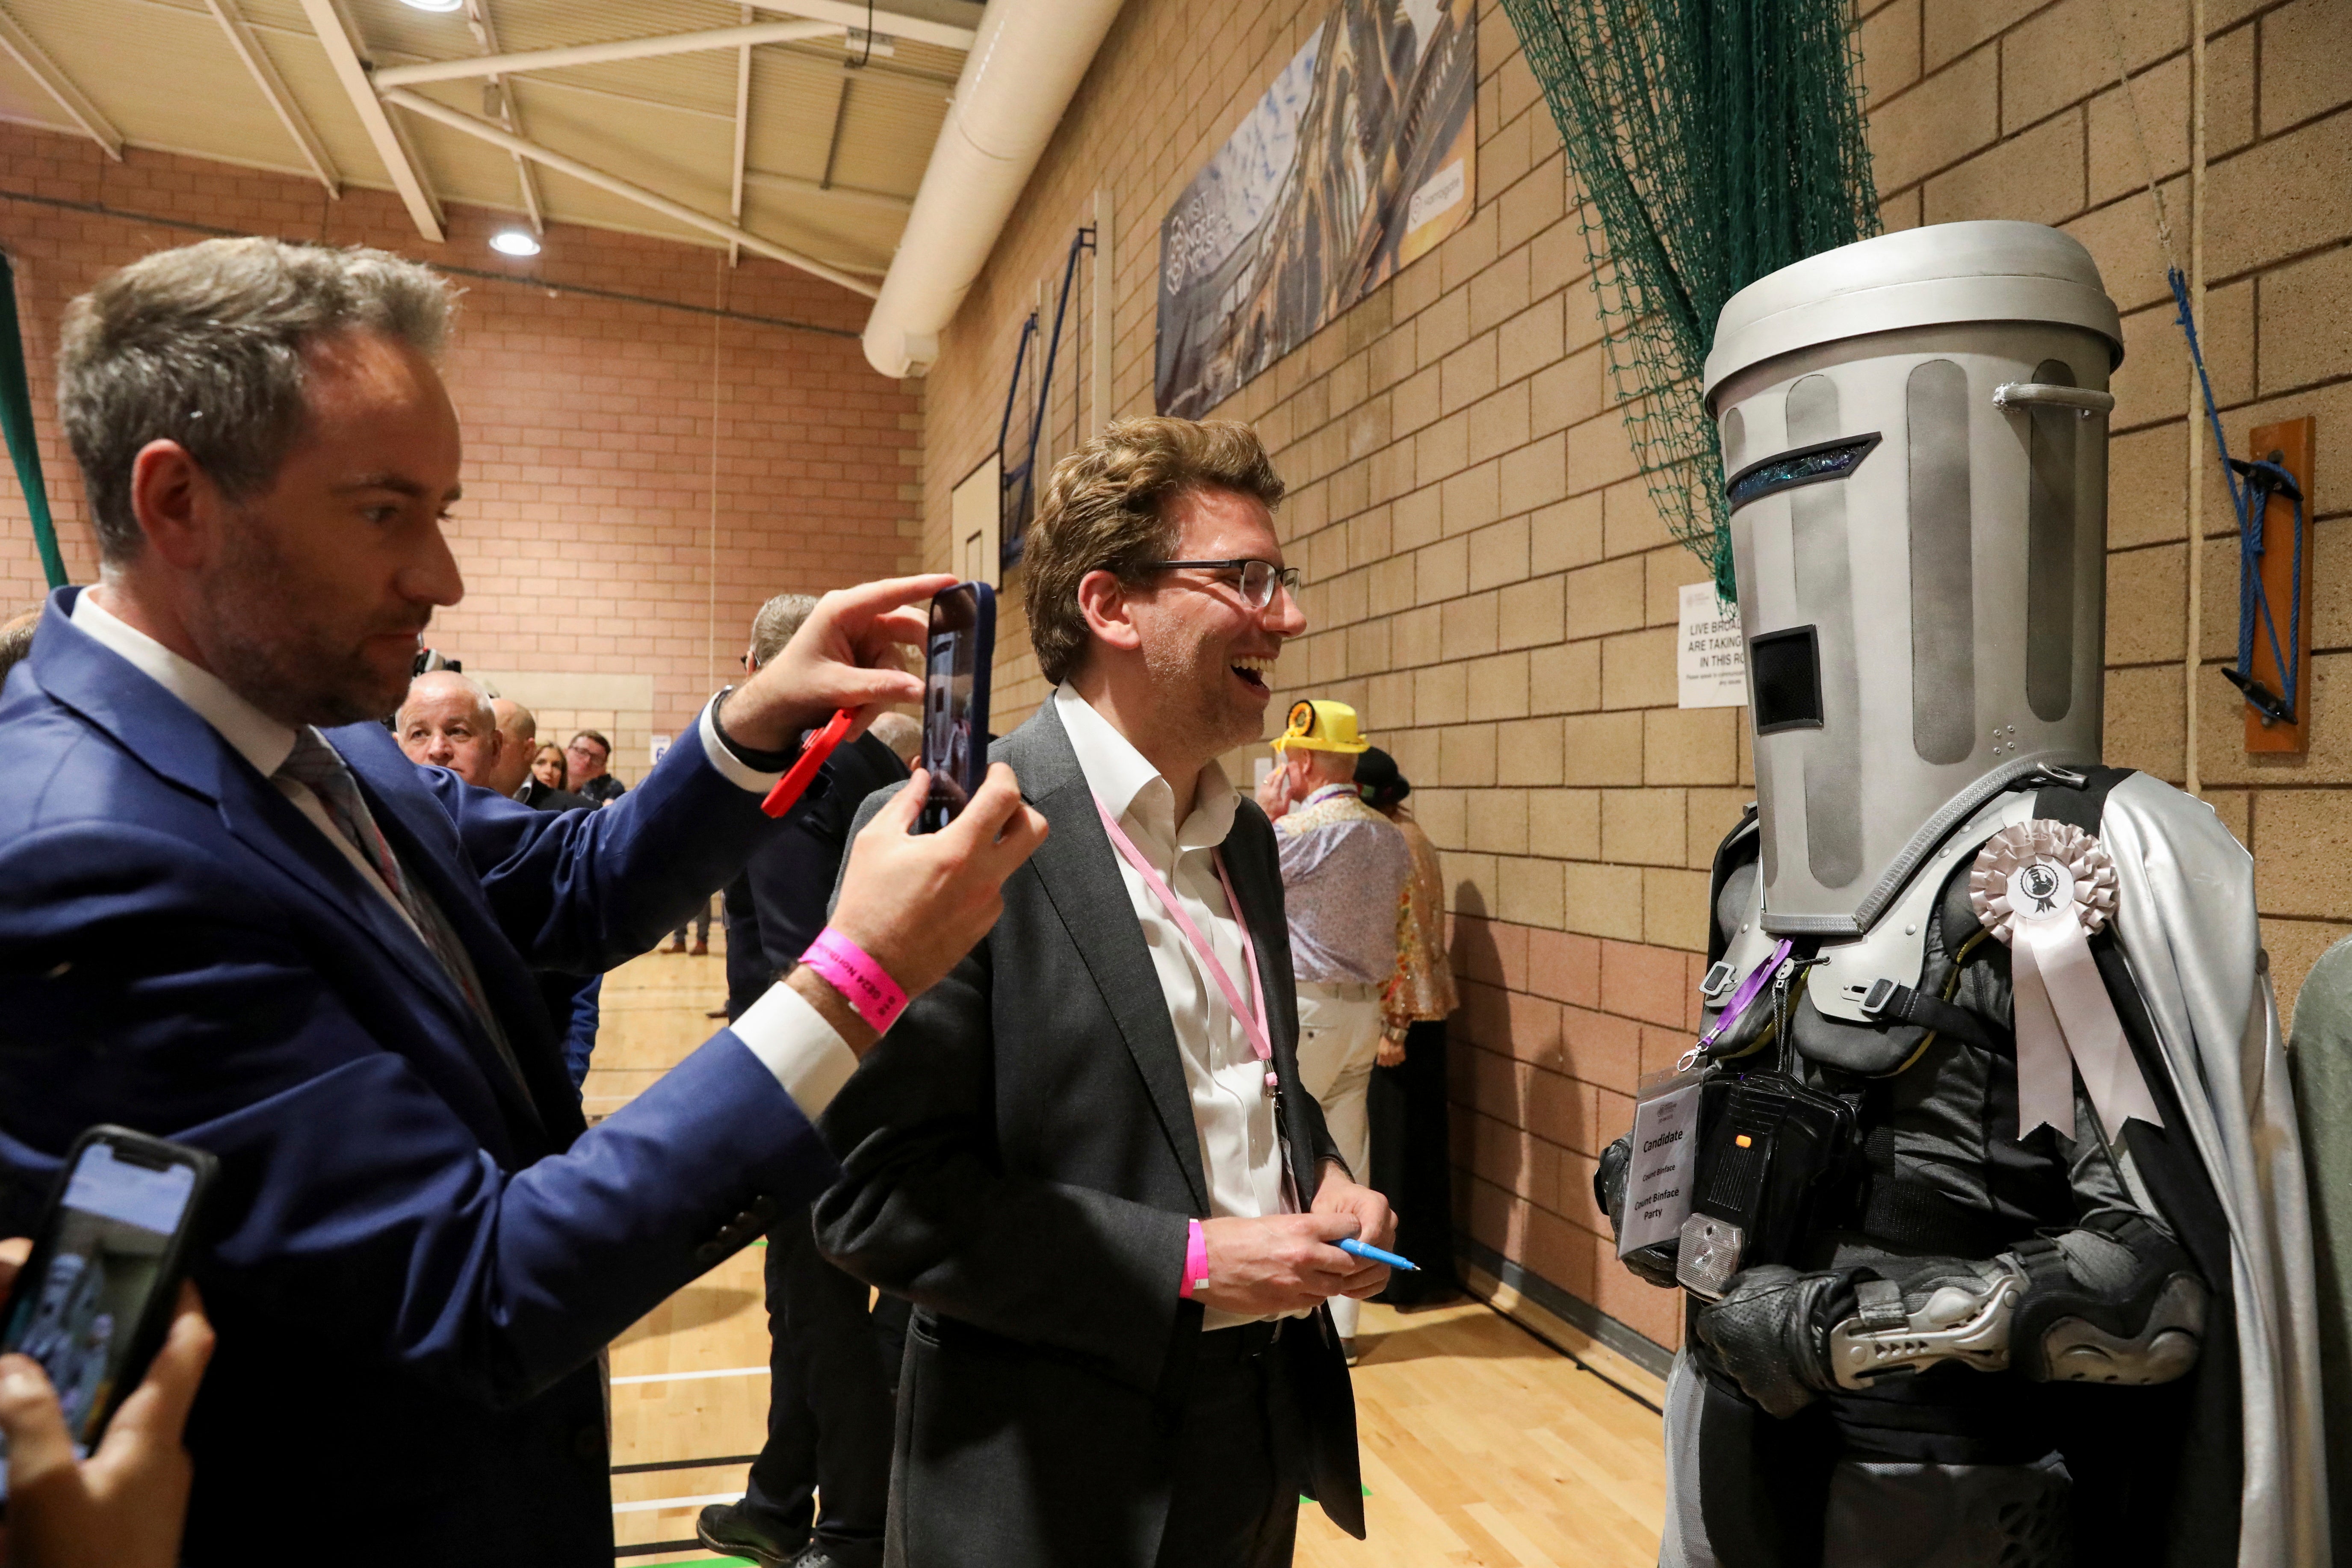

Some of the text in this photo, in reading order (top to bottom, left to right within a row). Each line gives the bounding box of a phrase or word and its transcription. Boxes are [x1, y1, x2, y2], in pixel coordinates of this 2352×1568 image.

[1690, 623, 1709, 635] LIVE
[1688, 636, 1741, 652] ARE TAKING
[1700, 656, 1709, 667] IN
[1711, 654, 1731, 666] THIS
[1643, 1130, 1683, 1153] Candidate
[1643, 1164, 1675, 1181] Count Binface
[1634, 1189, 1679, 1211] Count Binface
[1644, 1208, 1663, 1221] Party
